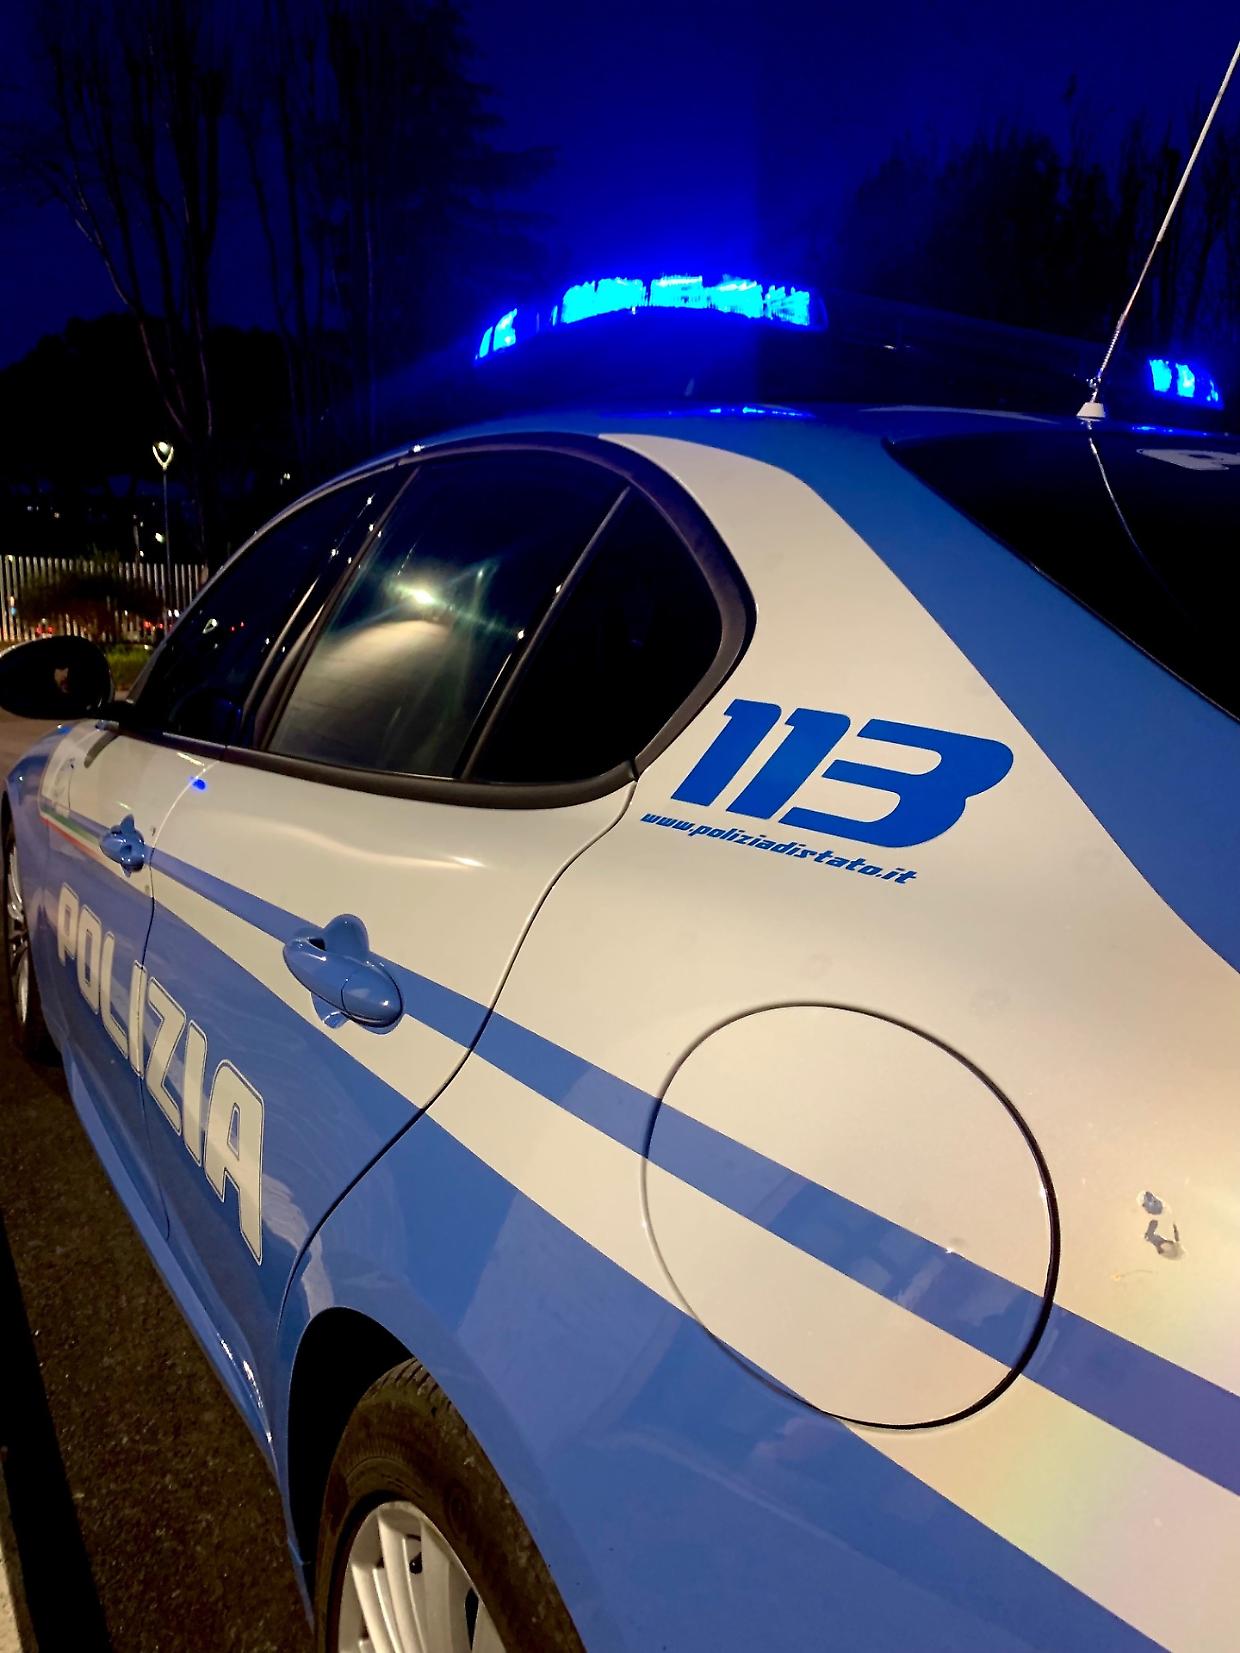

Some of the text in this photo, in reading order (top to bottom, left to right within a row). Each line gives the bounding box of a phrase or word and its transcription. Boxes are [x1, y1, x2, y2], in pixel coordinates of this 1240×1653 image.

[670, 698, 1014, 848] 113
[640, 813, 917, 884] www.poliziadistato.it
[58, 881, 265, 1266] POLIZIA
